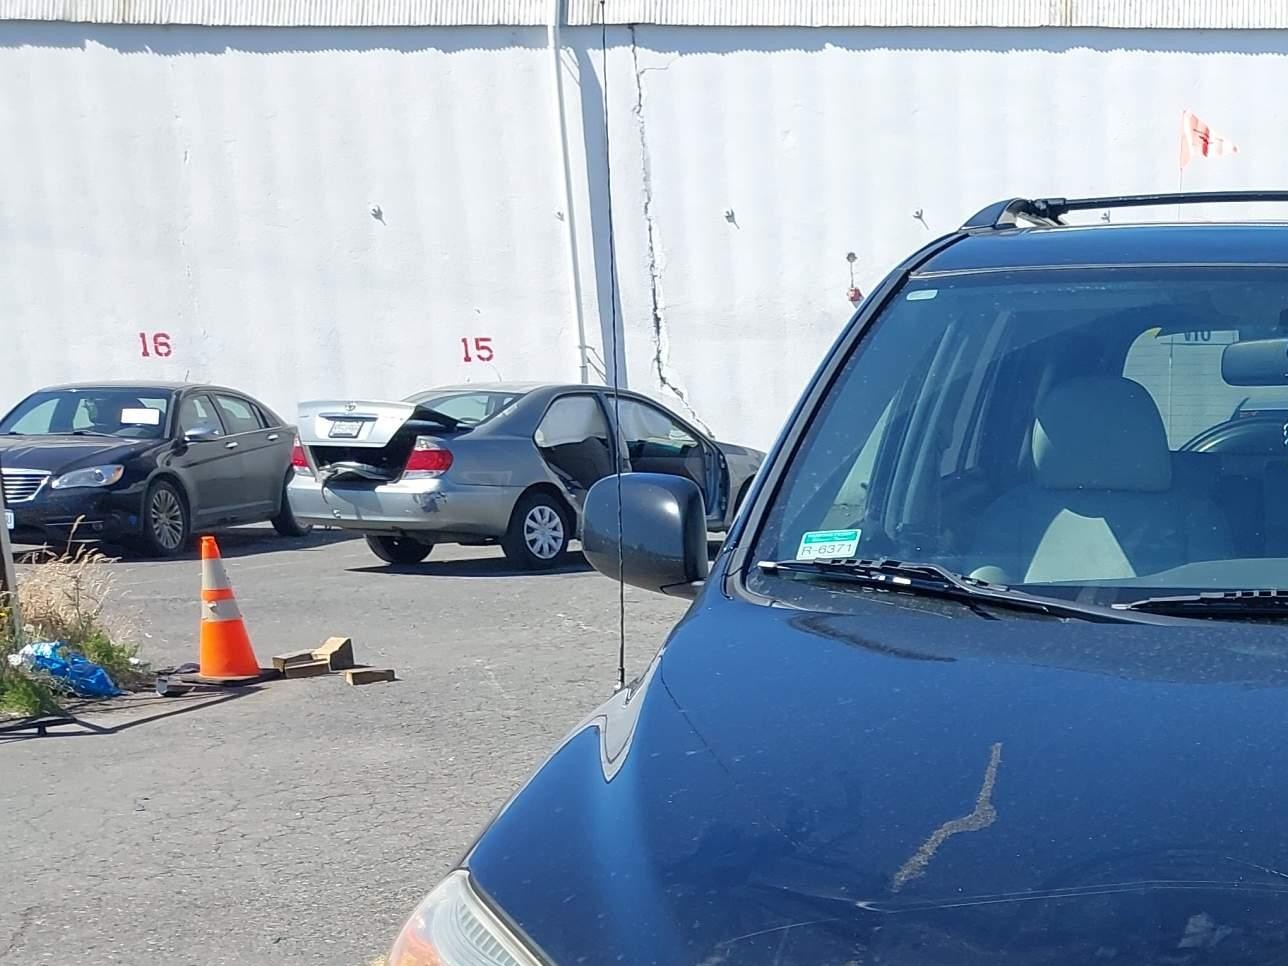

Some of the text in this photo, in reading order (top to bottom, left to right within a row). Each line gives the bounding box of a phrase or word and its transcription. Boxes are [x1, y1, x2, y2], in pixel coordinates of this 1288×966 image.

[139, 332, 172, 358] 16
[461, 337, 494, 362] 15
[801, 543, 852, 556] R-6371
